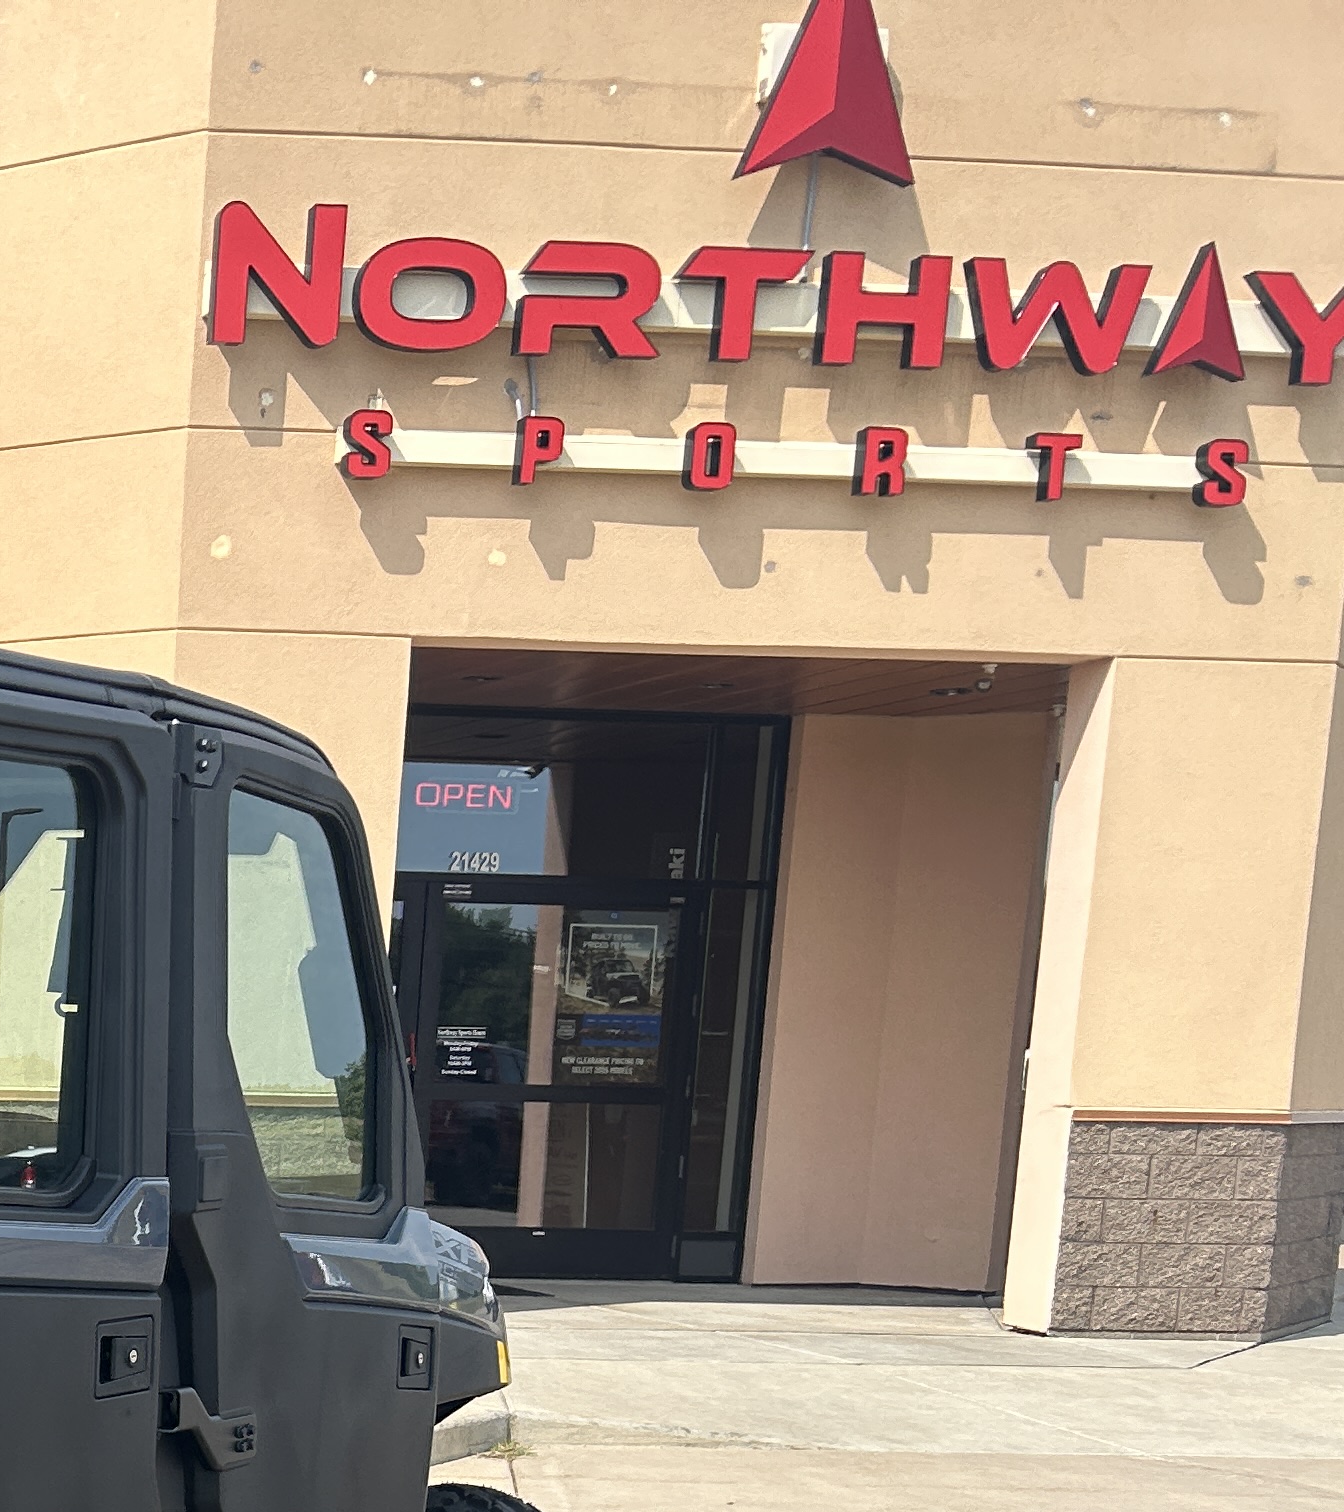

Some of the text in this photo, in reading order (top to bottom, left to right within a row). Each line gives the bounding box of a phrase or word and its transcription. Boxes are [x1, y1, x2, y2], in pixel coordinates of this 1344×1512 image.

[208, 201, 1344, 387] NORTHWAY
[342, 410, 1251, 508] SPORTS
[415, 782, 512, 809] OPEN
[449, 852, 500, 873] 21429
